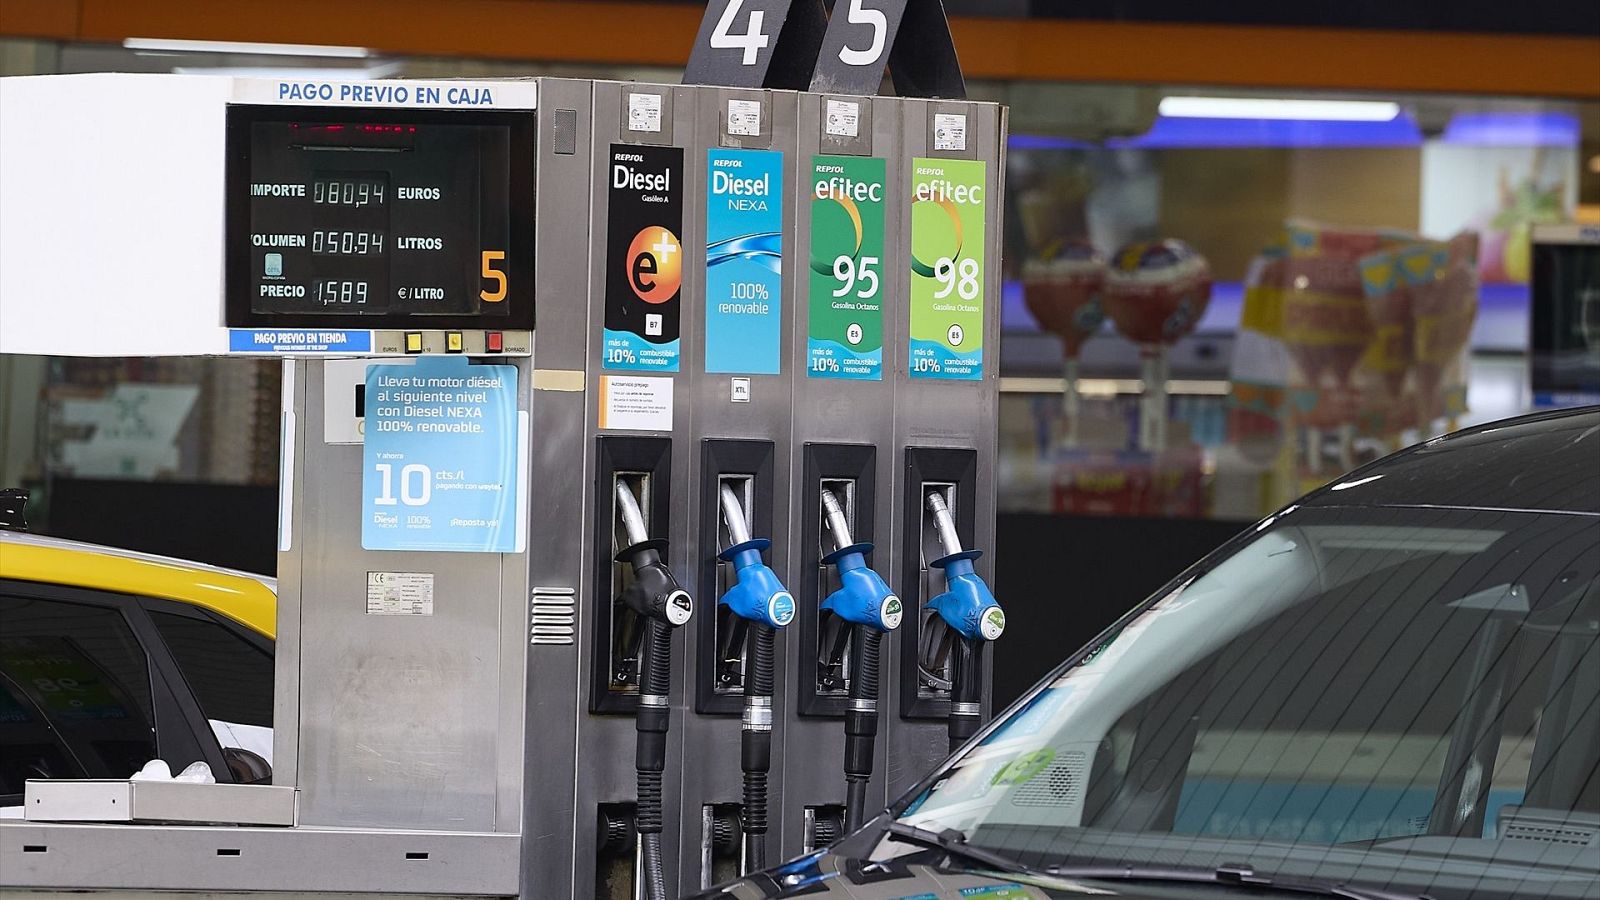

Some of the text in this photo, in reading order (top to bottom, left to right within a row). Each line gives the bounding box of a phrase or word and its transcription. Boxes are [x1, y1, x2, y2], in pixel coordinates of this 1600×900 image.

[709, 0, 769, 65] 4
[838, 0, 888, 66] 5
[279, 83, 493, 105] PAGO PREVIO EN CAJA
[615, 153, 644, 162] REPSOL
[713, 159, 743, 168] REPSOL
[816, 165, 844, 173] REPSOL
[917, 167, 944, 176] REPSOL
[613, 165, 670, 191] Diesel
[713, 171, 769, 196] Diesel
[250, 184, 306, 197] IMPORTE
[398, 188, 441, 200] EUROS
[815, 177, 882, 202] efitec
[916, 180, 981, 204] efitec
[641, 194, 664, 203] Gasóleo
[729, 199, 768, 211] NEXA
[251, 234, 306, 247] OLUMEN
[398, 238, 442, 250] LITROS
[479, 250, 508, 302] 5
[832, 255, 879, 298] 95
[934, 257, 979, 300] 98
[260, 285, 306, 298] PRECIO
[731, 282, 769, 300] 100%
[718, 302, 769, 315] renovable
[832, 301, 879, 311] Gasolina Octanos
[933, 303, 979, 313] Gasolina Octanos
[254, 333, 347, 344] PAGO PREVIO EN TIENDA
[608, 339, 621, 347] más
[607, 348, 636, 364] 10%
[639, 358, 668, 366] renovable
[843, 358, 877, 366] combustible
[944, 358, 978, 366] combustible
[812, 358, 839, 373] 10%
[843, 366, 870, 374] renovable
[913, 358, 941, 373] 10%
[944, 366, 971, 374] renovable
[378, 376, 503, 388] Lleva tu motor diésel
[735, 386, 747, 394] XTL
[377, 391, 487, 405] al siguiente nivel
[377, 406, 482, 418] con Diesel NEXA
[377, 421, 484, 433] 100% renovable.
[374, 463, 431, 506] 10
[374, 515, 398, 524] Diesel
[407, 515, 431, 524] 100%
